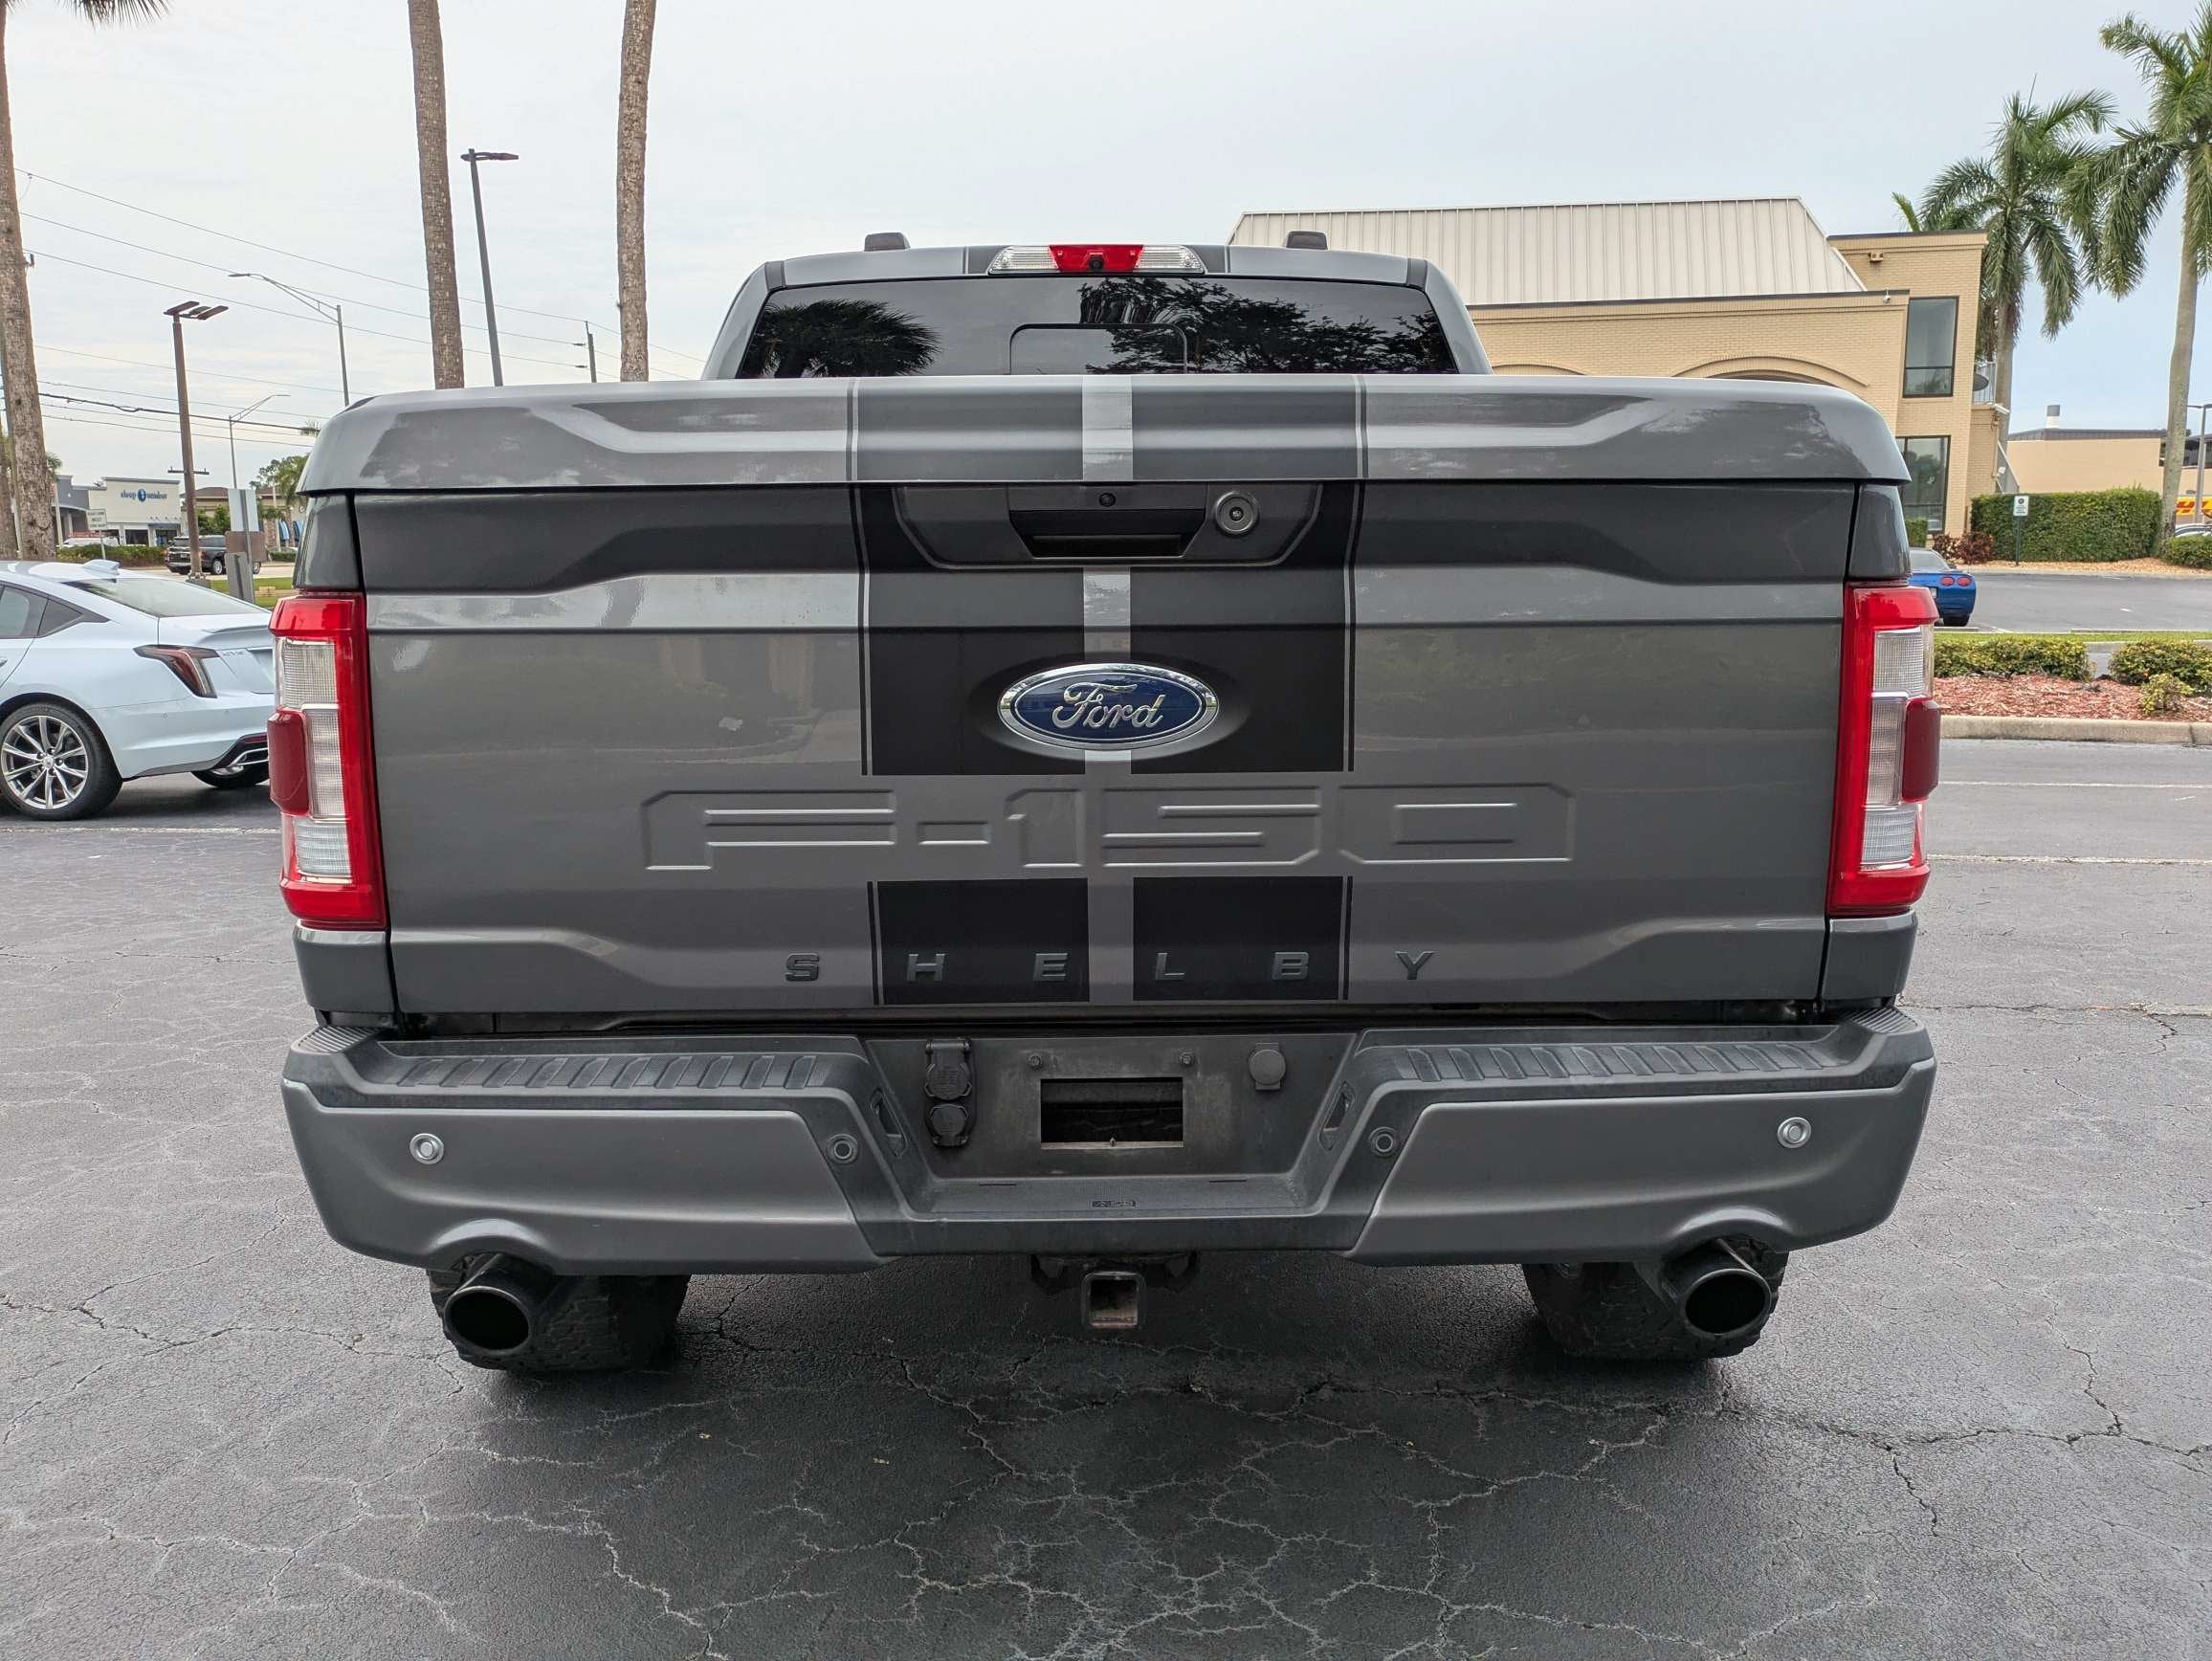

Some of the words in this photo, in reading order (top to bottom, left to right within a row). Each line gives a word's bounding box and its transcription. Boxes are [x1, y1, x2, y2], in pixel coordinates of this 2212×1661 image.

[1051, 681, 1166, 729] Ford
[639, 782, 1577, 871] F-150
[785, 950, 1434, 983] SHELBY
